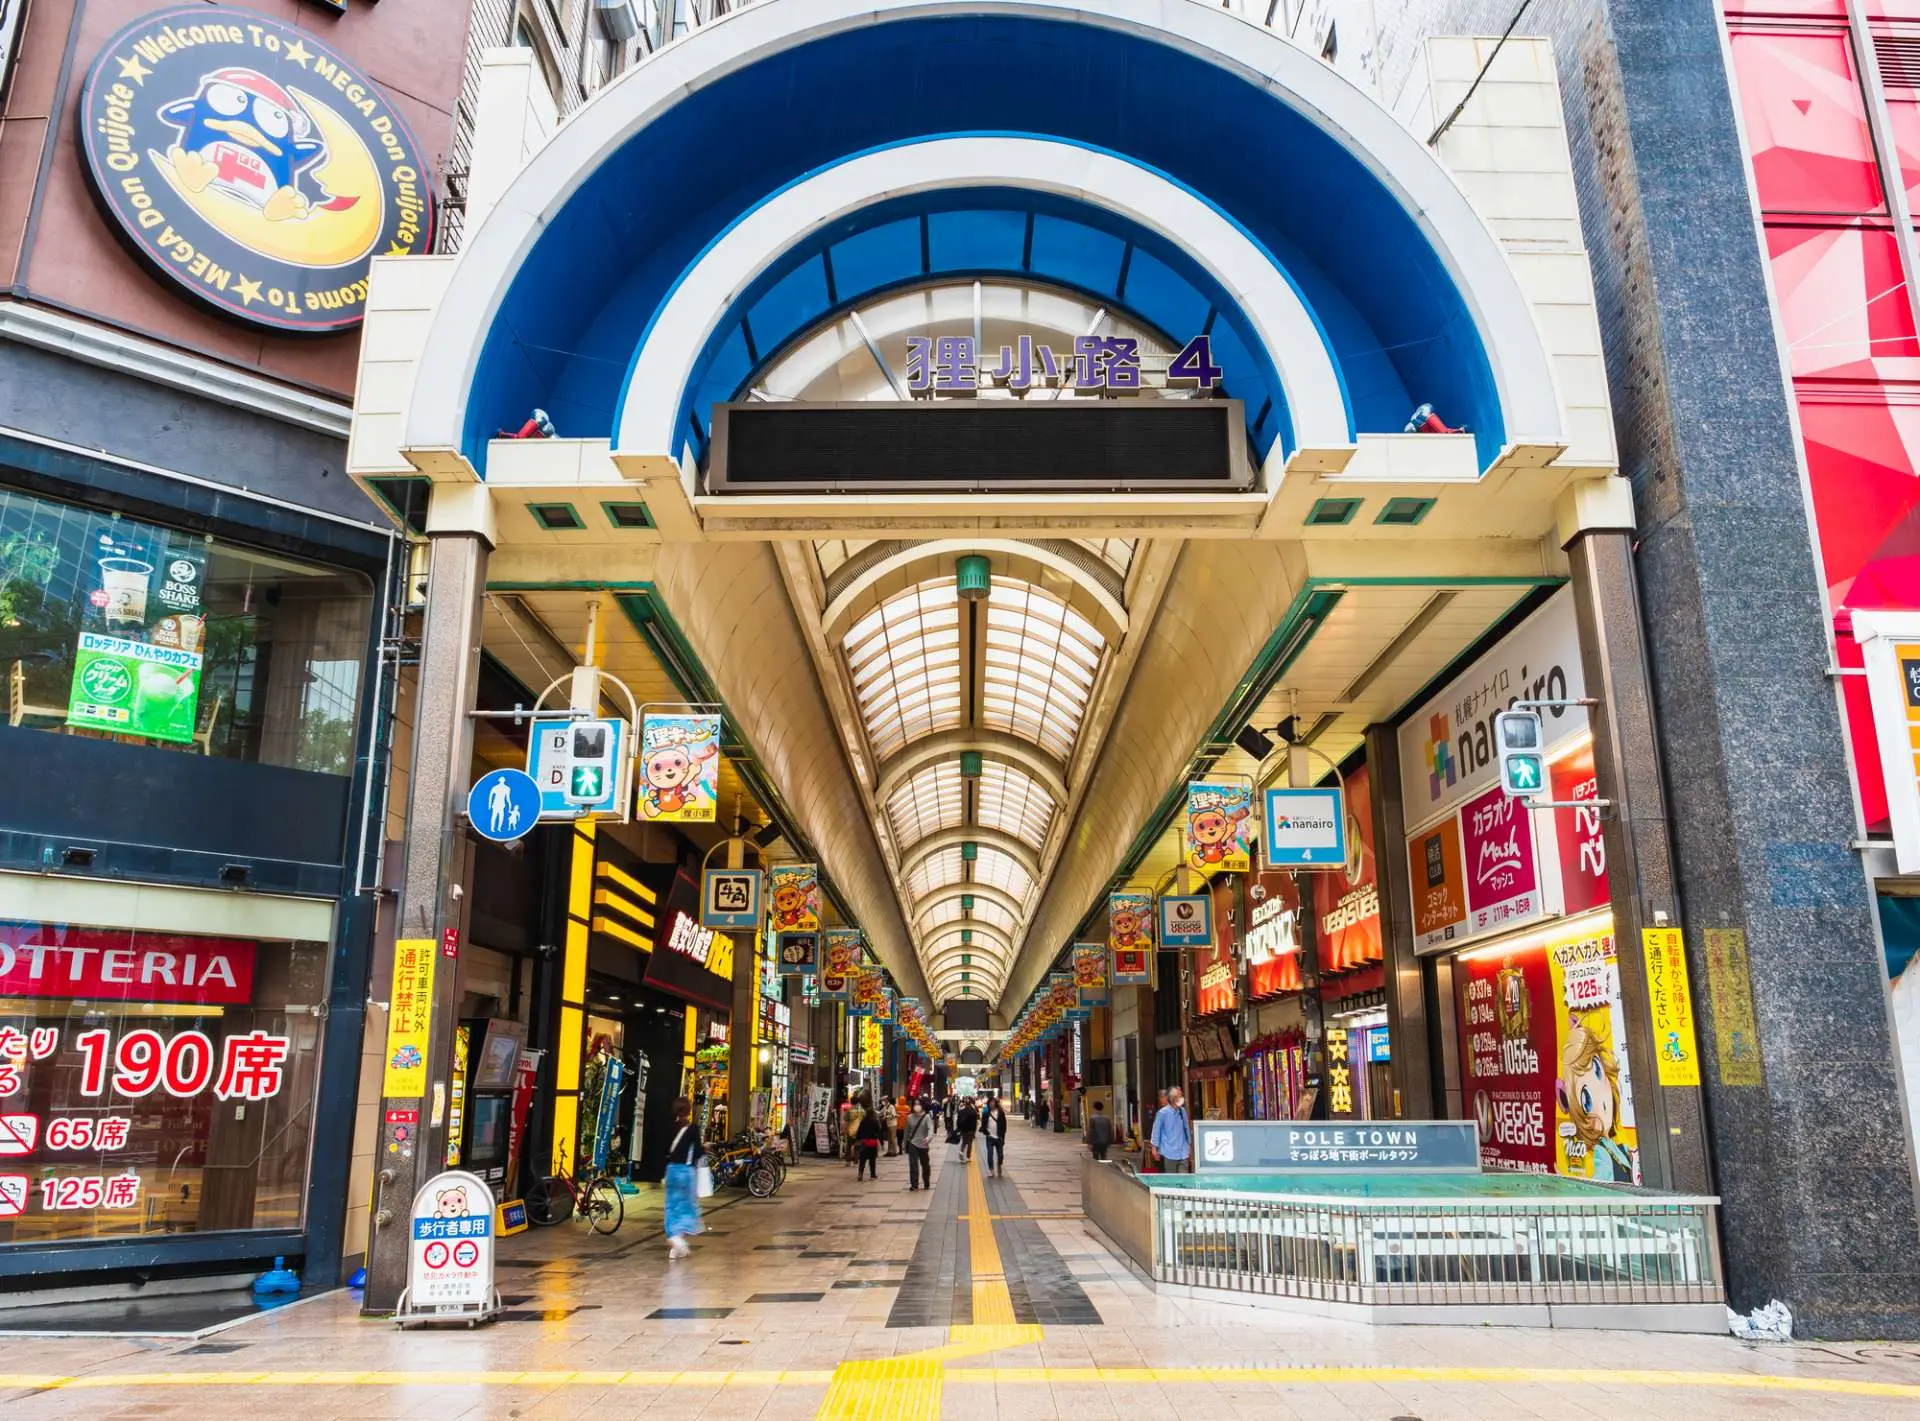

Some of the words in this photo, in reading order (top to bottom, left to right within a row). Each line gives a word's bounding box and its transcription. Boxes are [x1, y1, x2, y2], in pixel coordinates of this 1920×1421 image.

[97, 82, 136, 173] Quijote
[132, 22, 244, 66] Welcome
[247, 25, 281, 52] To
[313, 55, 377, 118] MEGA
[370, 115, 406, 161] Don
[391, 165, 425, 245] Quijote
[120, 177, 165, 230] Don
[156, 227, 232, 292] MEGA
[267, 286, 302, 315] To
[305, 273, 370, 311] come
[906, 335, 1141, 397] 狸小路
[1167, 335, 1224, 389] 4
[158, 588, 200, 606] SHAKE
[165, 580, 197, 596] BOSS
[83, 635, 131, 652] ロッテリア
[133, 644, 199, 667] ひんやりカフェ
[84, 668, 128, 688] クリーム
[1454, 668, 1511, 730] 札幌ナナイロ
[710, 723, 719, 737] 2
[1457, 664, 1567, 779] naniro
[1242, 791, 1250, 802] 2
[1292, 819, 1334, 830] nanairo
[1472, 794, 1515, 837] カラオケ
[1301, 848, 1313, 861] 4
[1477, 825, 1522, 872] Mash
[1490, 872, 1515, 890] マッシュ
[1421, 901, 1459, 929] インターネット
[393, 948, 417, 1034] 通行禁止
[414, 948, 431, 1034] 許可車両以外
[1666, 931, 1689, 1029] 自転車から降りて
[76, 1028, 290, 1102] 190席
[1502, 1038, 1540, 1075] 1055台
[1492, 1091, 1521, 1100] PACHINKO
[1526, 1091, 1542, 1100] SLOT
[390, 1112, 413, 1121] 4-1
[1492, 1101, 1544, 1126] VEGAS
[46, 1116, 131, 1151] 65席
[1289, 1131, 1346, 1145] POLE
[1356, 1131, 1417, 1145] TOWN
[1494, 1120, 1546, 1147] VEGAS
[1289, 1150, 1418, 1162] さっぽろ地下街ポールタウン
[40, 1173, 141, 1211] 125席
[419, 1218, 486, 1237] 歩行者専用
